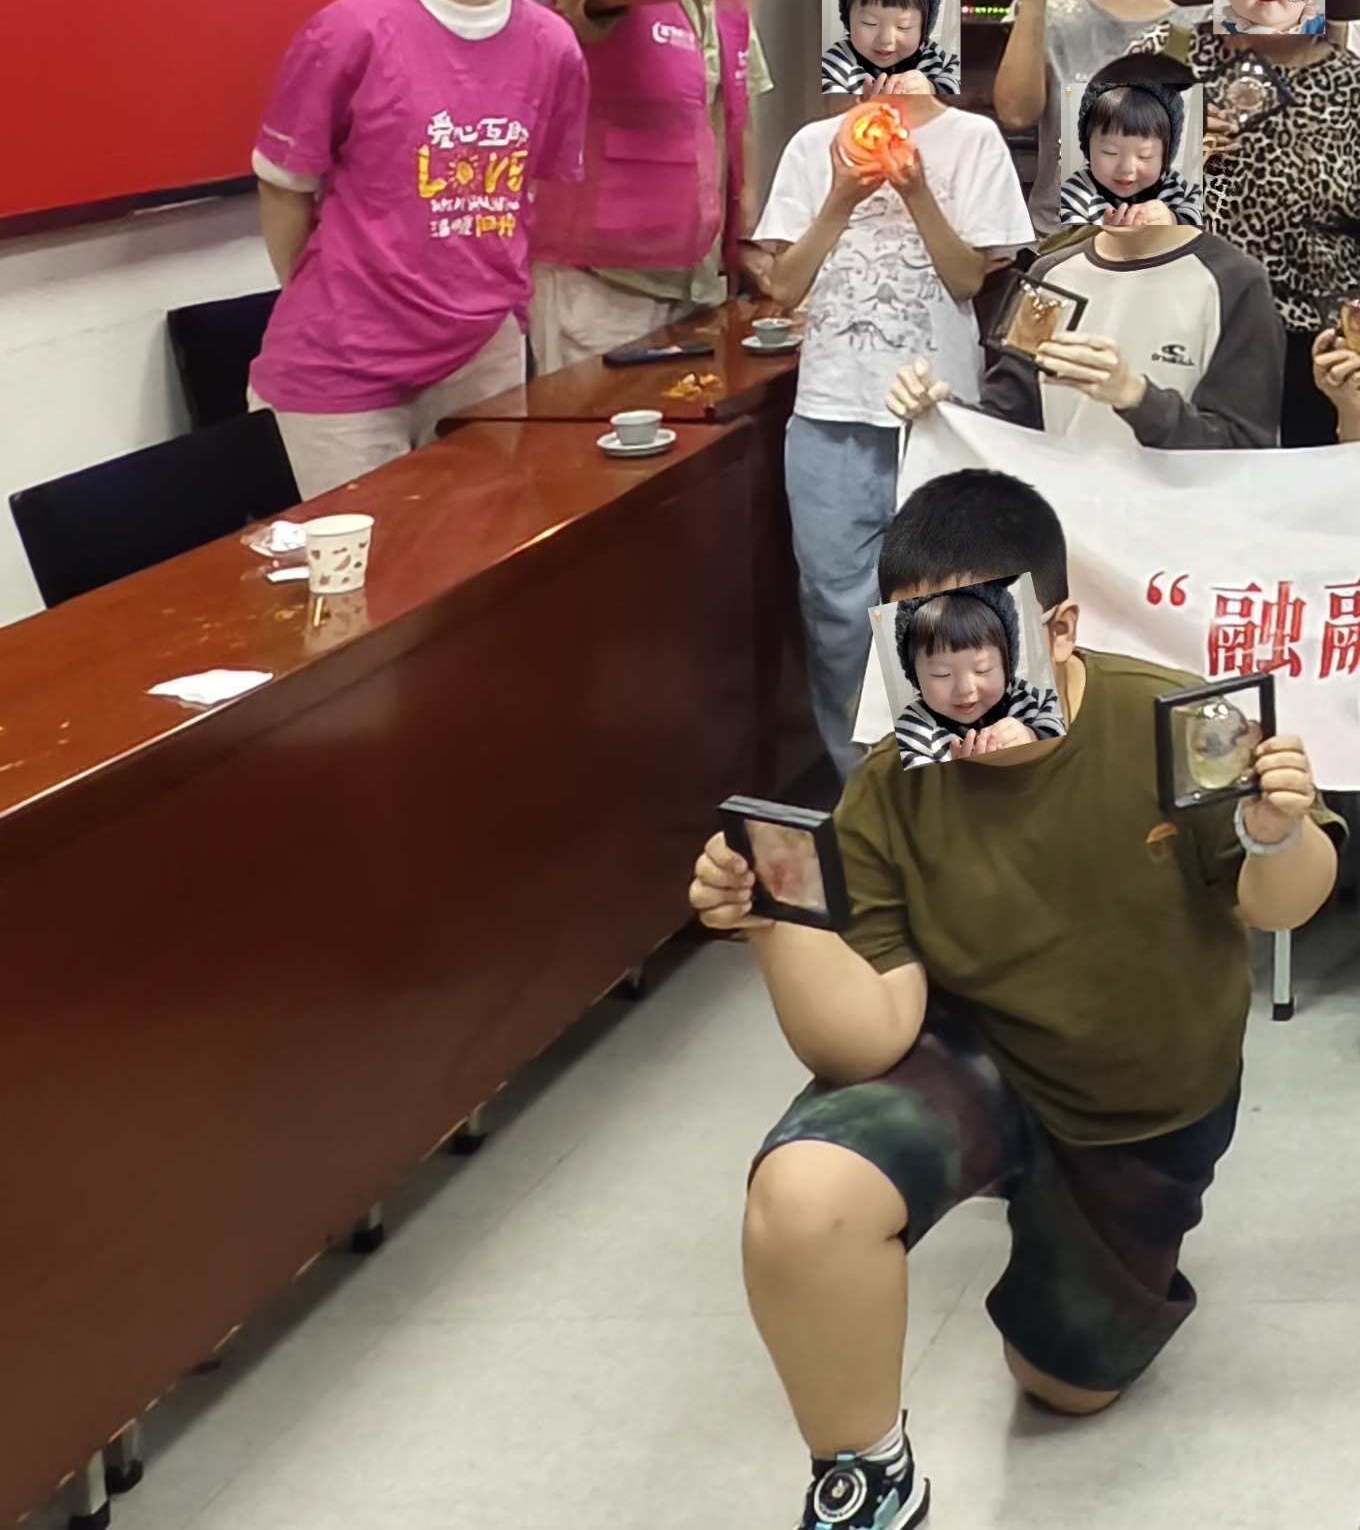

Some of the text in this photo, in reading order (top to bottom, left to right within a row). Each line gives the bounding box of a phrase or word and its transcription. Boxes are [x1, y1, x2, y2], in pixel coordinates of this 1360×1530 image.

[428, 110, 530, 149] 爱心互助
[417, 144, 528, 198] LOVE
